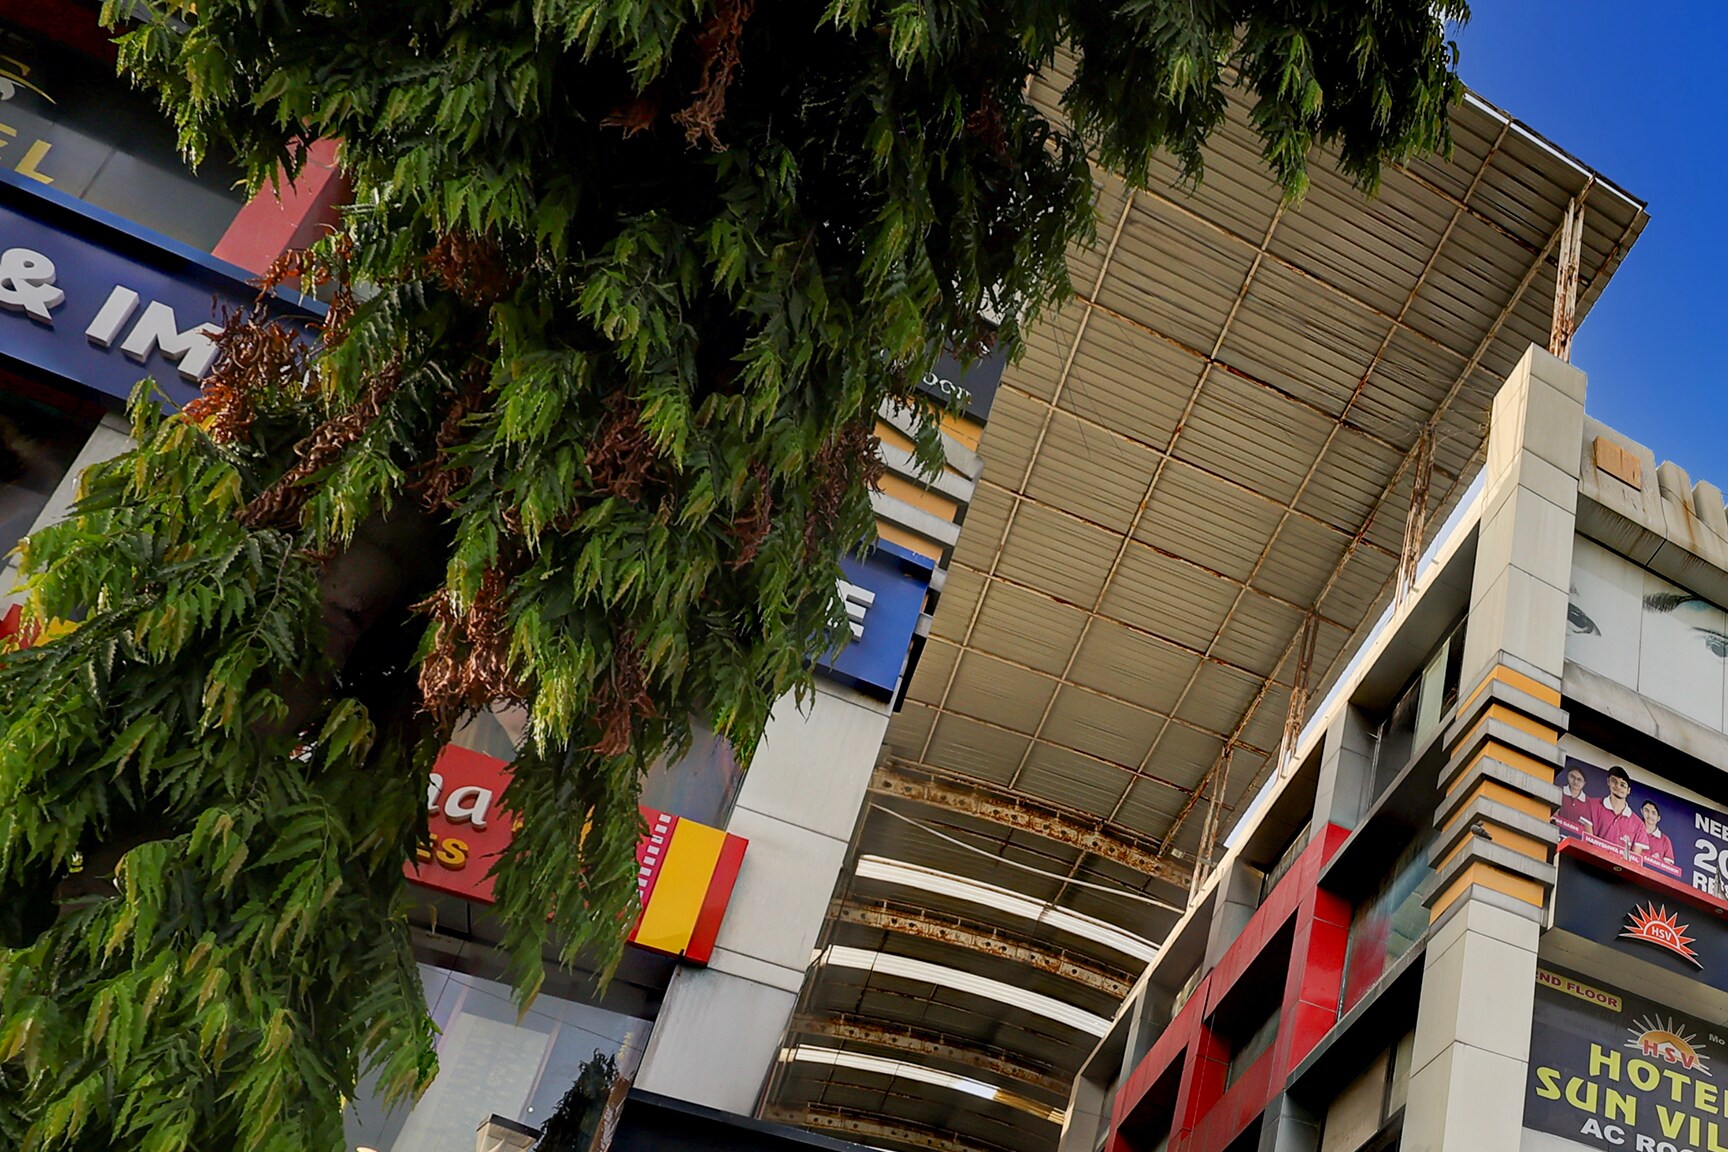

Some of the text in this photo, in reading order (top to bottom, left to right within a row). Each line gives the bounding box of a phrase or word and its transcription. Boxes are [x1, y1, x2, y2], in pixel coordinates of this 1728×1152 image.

[1650, 925, 1672, 943] HSV
[1537, 971, 1619, 1009] ND FLOOR
[1642, 1038, 1695, 1070] HSV
[1708, 1032, 1726, 1046] Mo
[1535, 1065, 1637, 1128] SUN
[1580, 1116, 1625, 1146] AC
